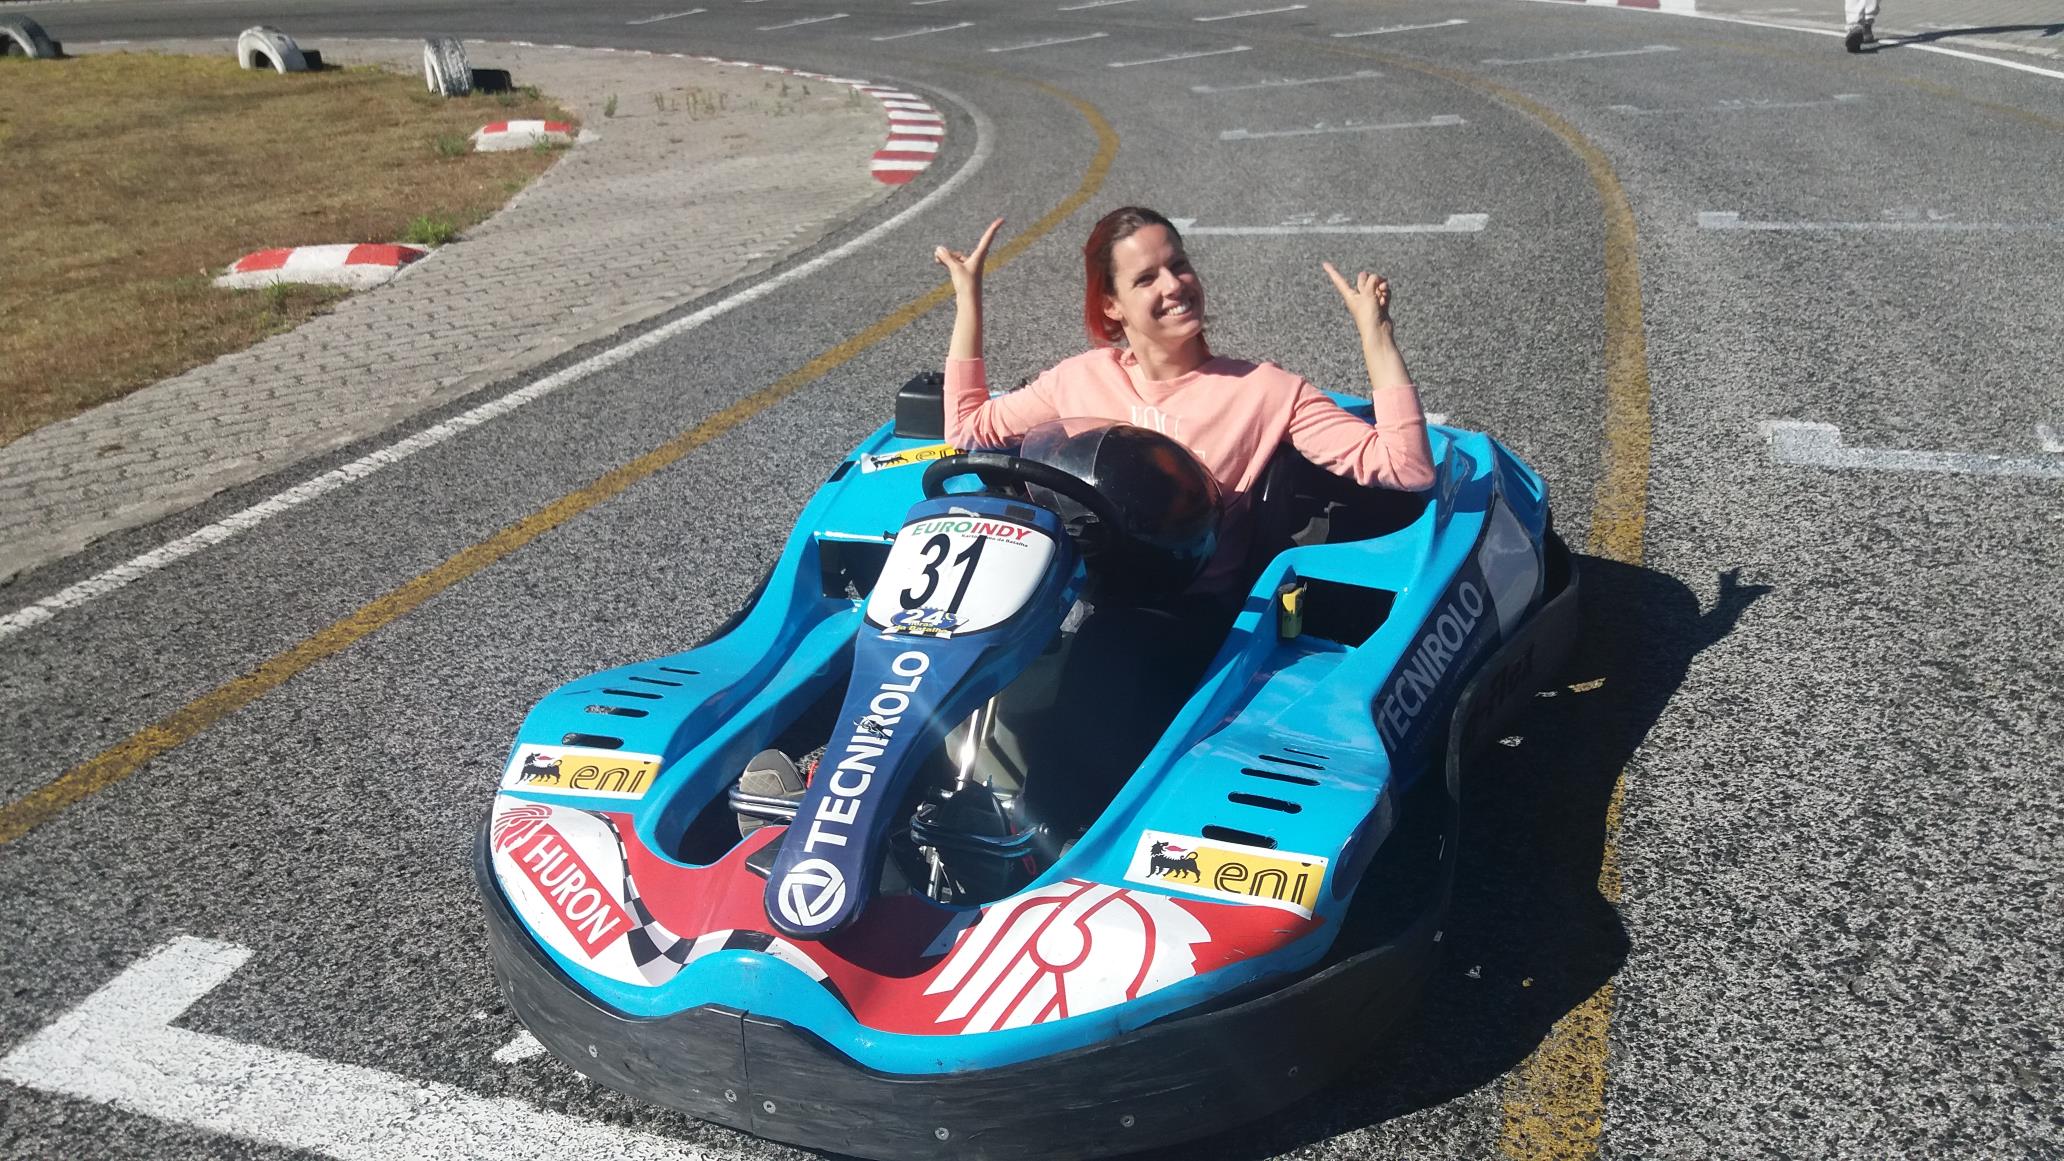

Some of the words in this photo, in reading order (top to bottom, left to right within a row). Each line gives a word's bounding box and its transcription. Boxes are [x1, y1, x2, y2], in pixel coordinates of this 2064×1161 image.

[916, 447, 965, 461] en
[912, 521, 1032, 540] EUROINDY
[900, 533, 987, 615] 31
[900, 609, 945, 625] 24
[1377, 581, 1483, 752] TECNIROLO
[804, 651, 930, 852] TECNIROLO
[569, 761, 652, 793] eni
[522, 835, 621, 945] HURON
[1214, 862, 1309, 905] eni
